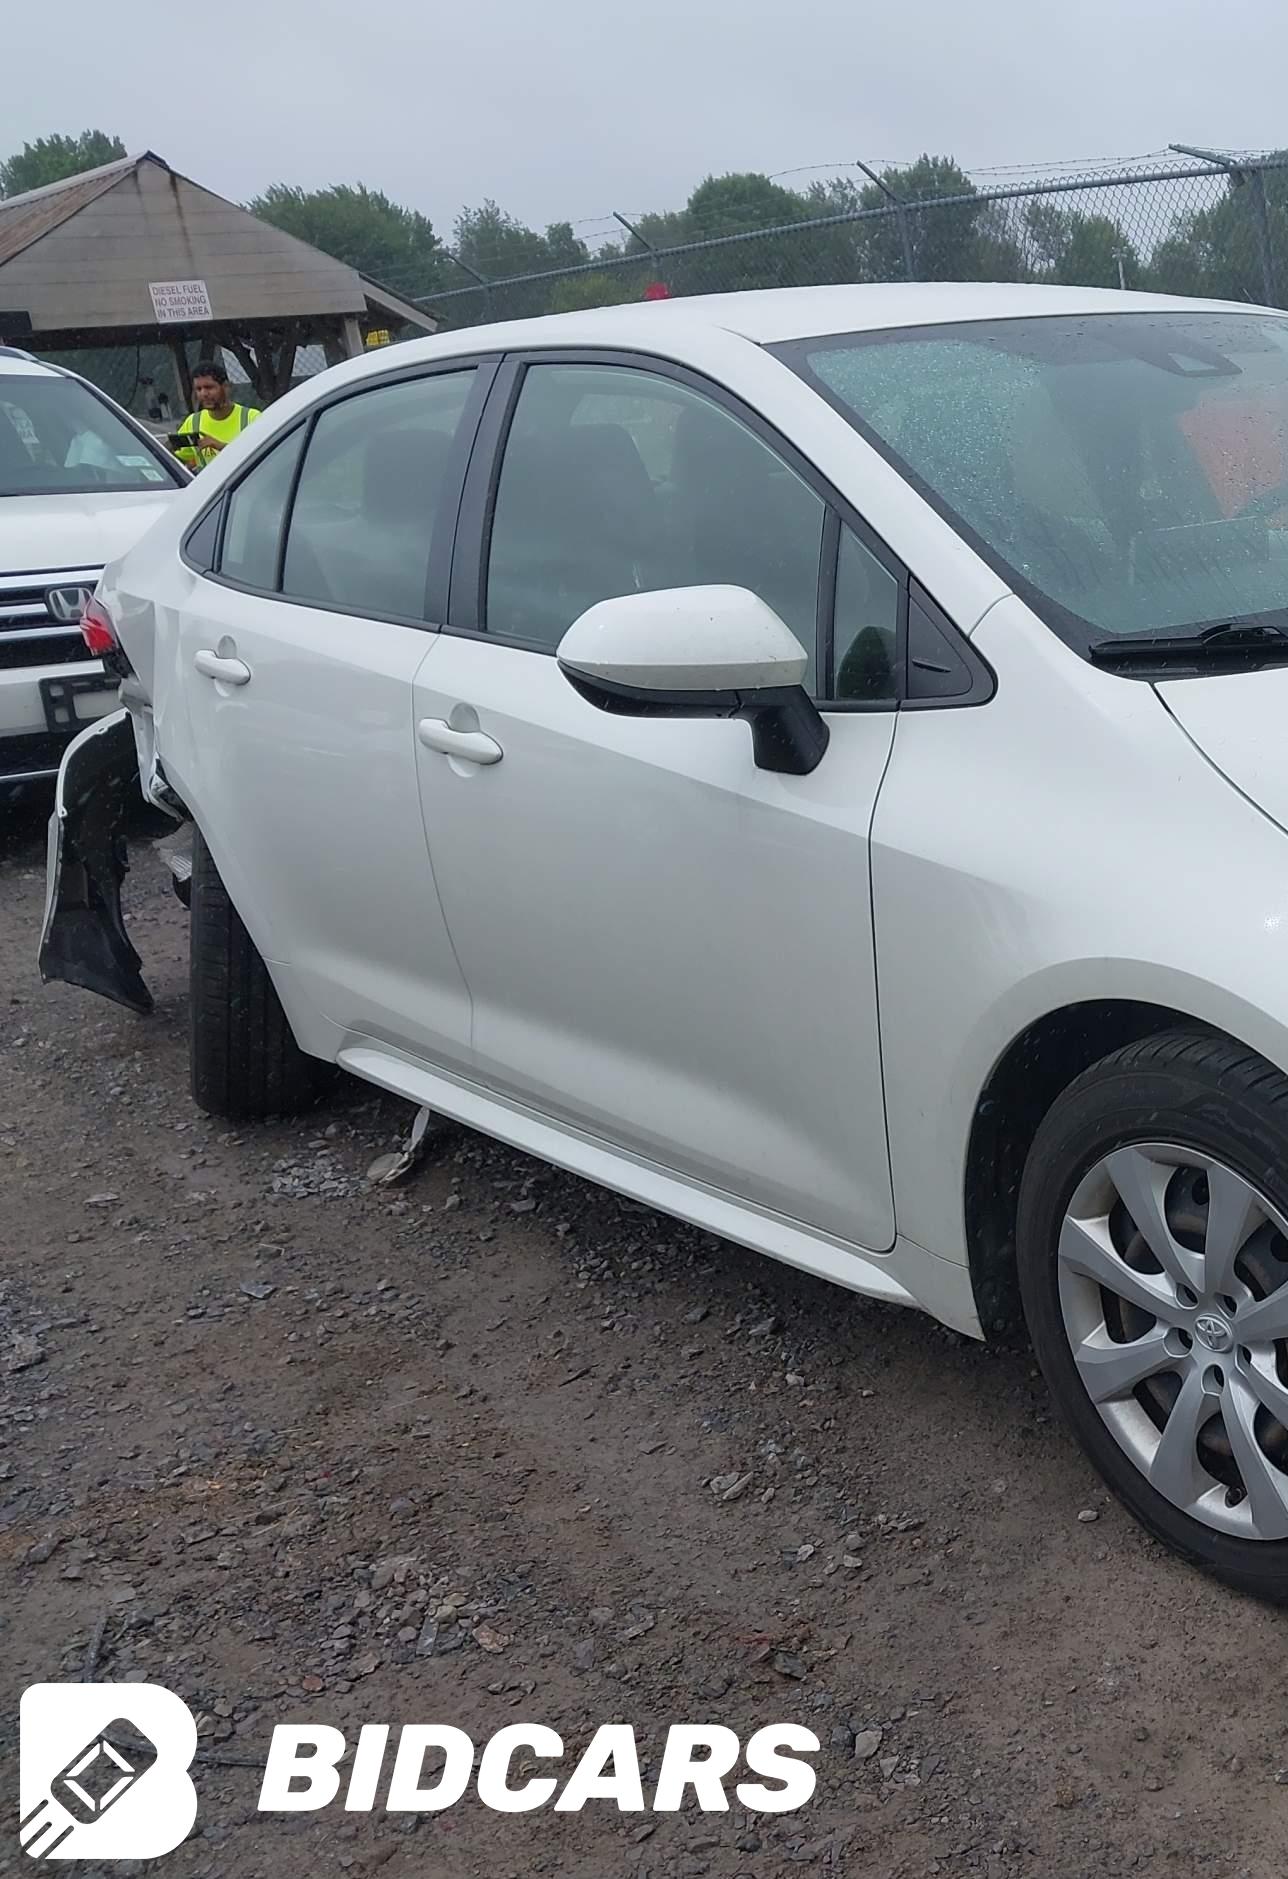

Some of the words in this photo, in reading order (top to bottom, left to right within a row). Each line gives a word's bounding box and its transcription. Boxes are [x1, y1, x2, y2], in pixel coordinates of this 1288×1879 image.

[152, 286, 182, 295] DIESEL
[182, 284, 203, 294] FUEL
[155, 297, 168, 306] NO
[169, 295, 206, 305] SMOKING
[157, 309, 167, 318] IN
[167, 306, 186, 318] THIS
[187, 305, 209, 315] AREA
